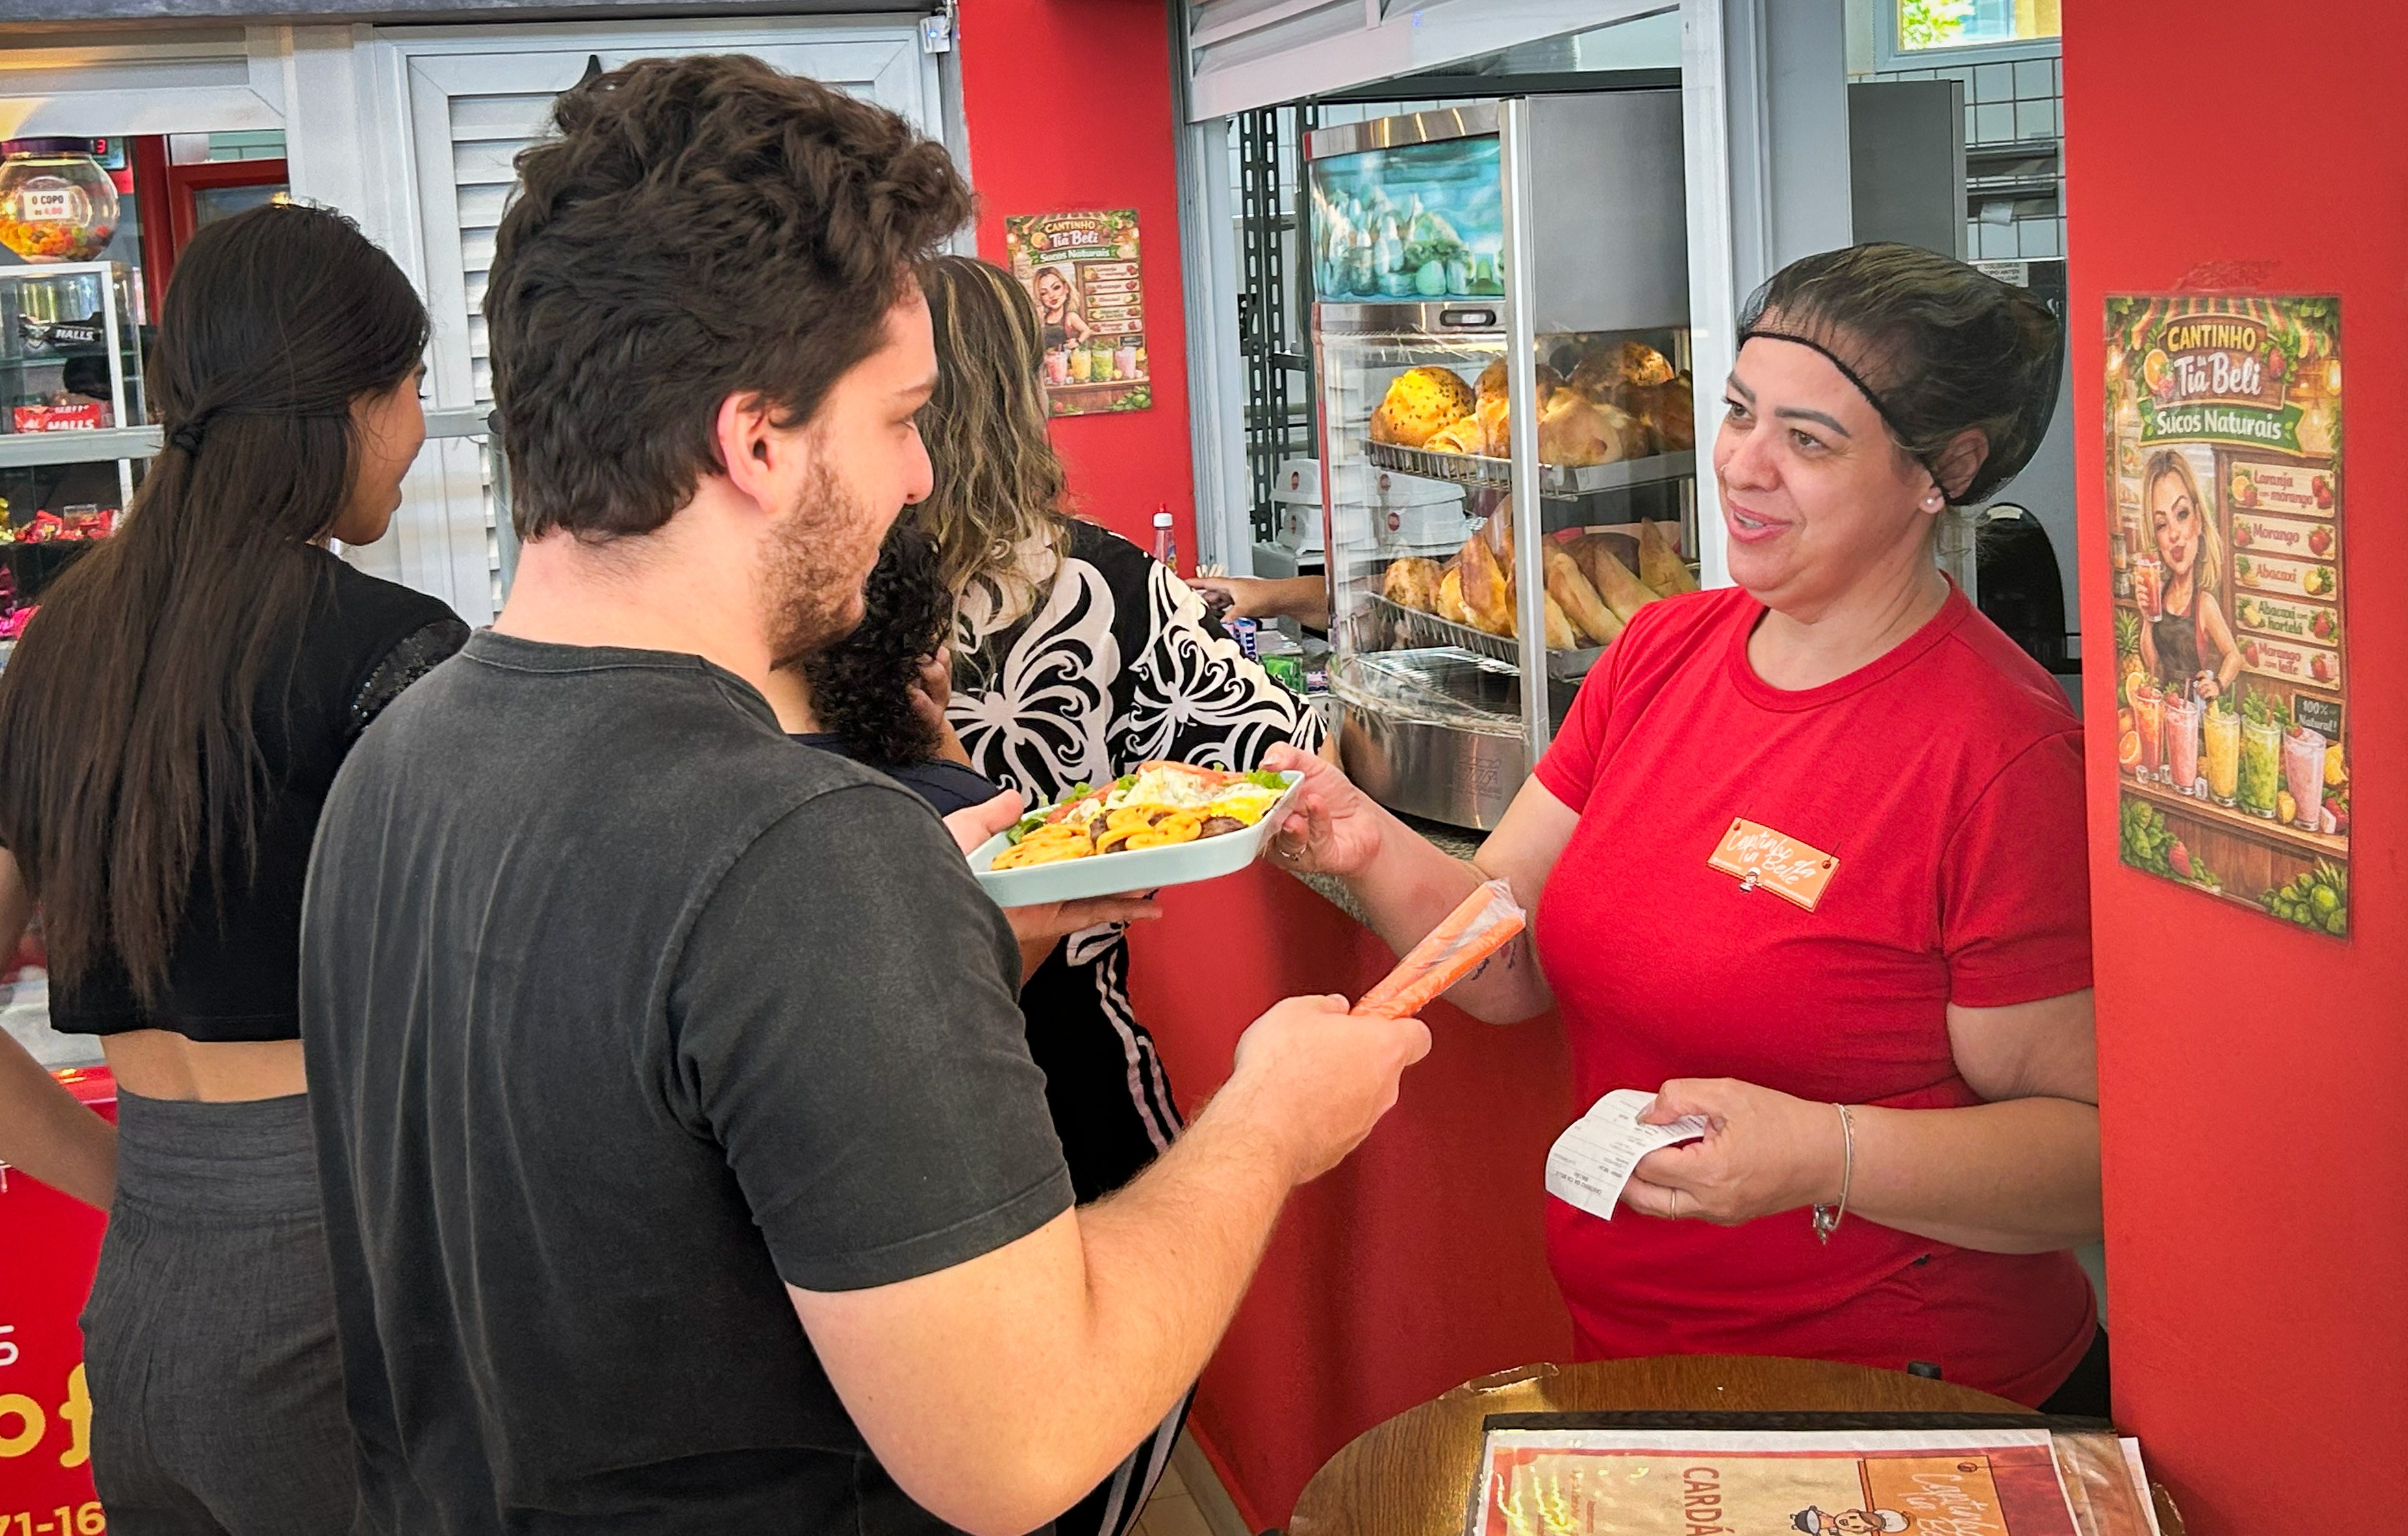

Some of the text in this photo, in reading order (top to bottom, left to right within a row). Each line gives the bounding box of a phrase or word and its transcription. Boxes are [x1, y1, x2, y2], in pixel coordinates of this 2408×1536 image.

[41, 195, 64, 205] COPO
[1045, 220, 1096, 233] CANTINHO
[1049, 230, 1099, 248] Tia Beli
[55, 328, 94, 340] HALLS
[2167, 325, 2257, 352] CANTINHO
[2174, 352, 2262, 396] Tia Beli
[2157, 409, 2282, 441] Sucos Naturais
[2254, 469, 2294, 491] Laranja
[2270, 491, 2314, 509] morango
[2253, 522, 2300, 546] Morango
[2256, 563, 2298, 583] Abacaxi
[2259, 600, 2296, 619] Abacaxi
[2259, 643, 2301, 661] Morango
[2278, 659, 2300, 675] leite
[2303, 700, 2328, 715] 100%
[2298, 714, 2337, 732] Natural!
[1726, 830, 1794, 859] Cantinho
[1761, 854, 1800, 884] Belle
[1683, 1467, 1735, 1536] CARDÁ
